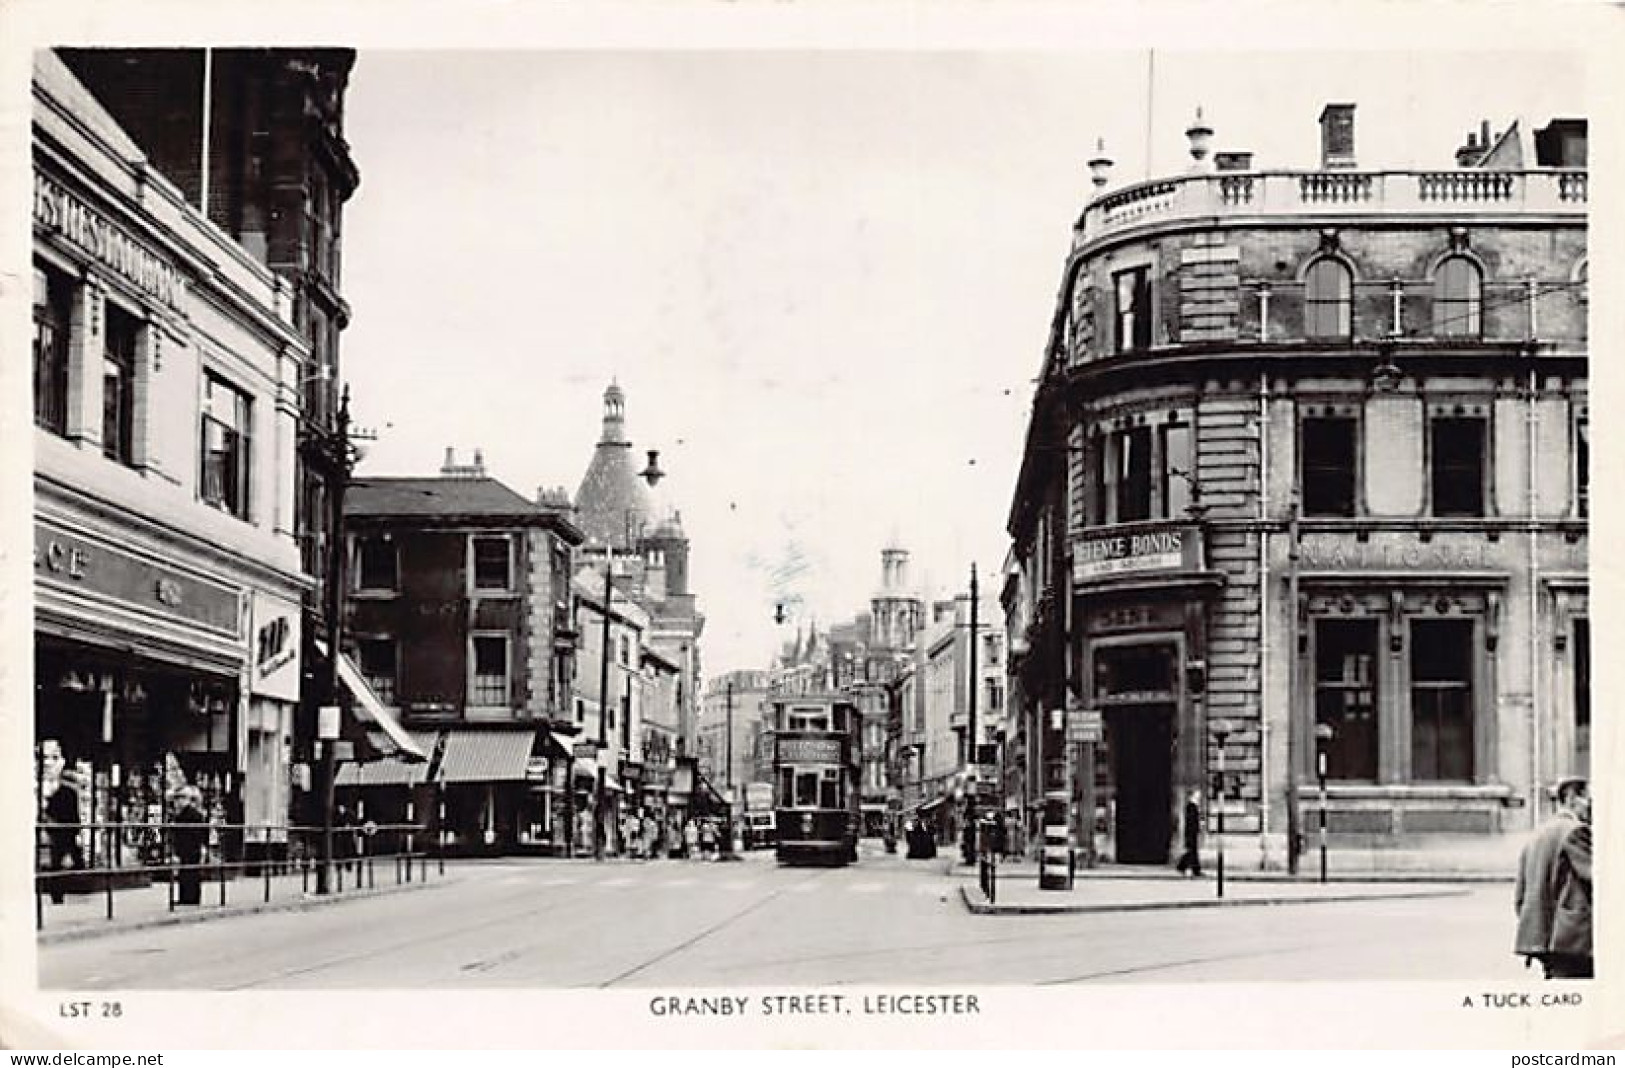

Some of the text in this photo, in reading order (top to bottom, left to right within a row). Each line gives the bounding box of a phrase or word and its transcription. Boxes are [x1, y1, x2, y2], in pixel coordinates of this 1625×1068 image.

[1132, 532, 1181, 557] BONDS
[59, 1001, 123, 1018] LST 28
[649, 996, 749, 1016] GRANBY
[864, 994, 980, 1015] LEICESTER
[1462, 992, 1583, 1008] A TUCK CARD
